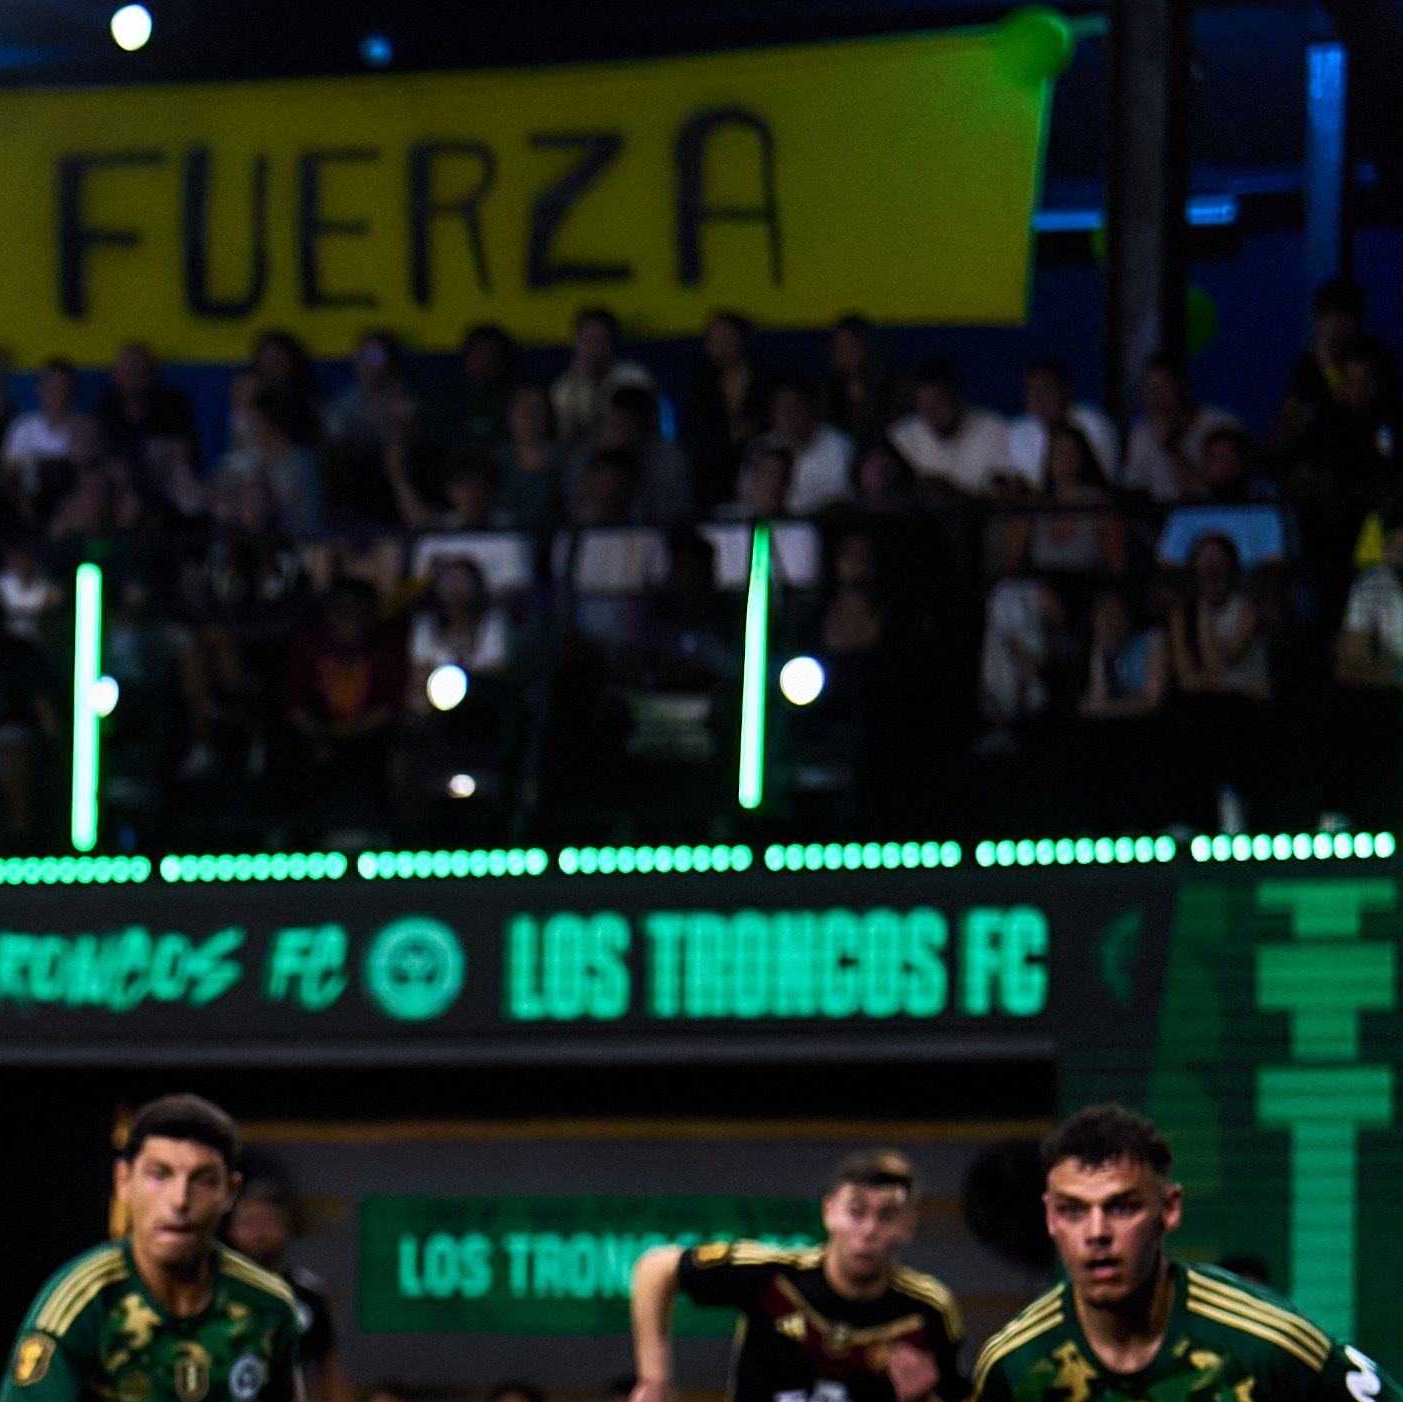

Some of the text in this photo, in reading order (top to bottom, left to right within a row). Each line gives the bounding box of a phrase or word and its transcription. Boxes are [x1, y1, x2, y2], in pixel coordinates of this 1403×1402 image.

[52, 108, 786, 322] FUERZA
[507, 904, 1050, 1020] LOS TRONCOS FC
[398, 1231, 733, 1299] LOS TRON
